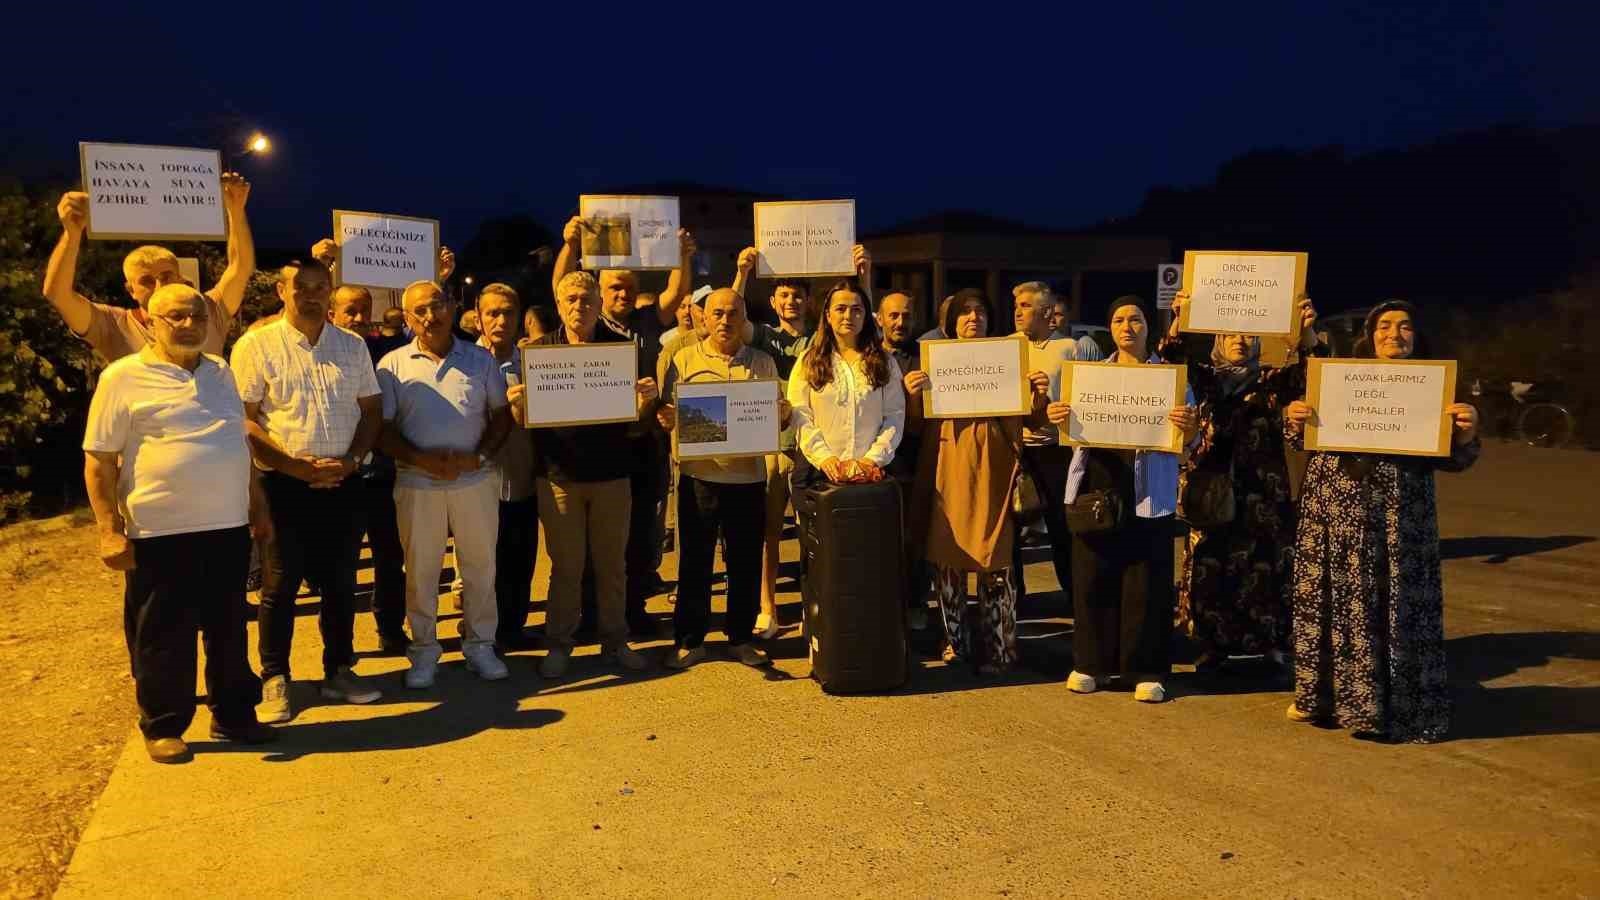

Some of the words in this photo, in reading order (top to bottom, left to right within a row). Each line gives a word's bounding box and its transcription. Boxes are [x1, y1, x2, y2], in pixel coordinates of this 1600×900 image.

[95, 159, 145, 172] İNSANA
[161, 162, 214, 175] TOPRAĞA
[92, 177, 150, 189] HAVAYA
[171, 178, 205, 189] SUYA
[96, 193, 149, 205] ZEHİRE
[163, 194, 204, 205] HAYIR
[344, 227, 425, 242] GELECEĞİMİZE
[367, 242, 407, 255] SAĞLIK
[354, 255, 416, 270] BIRAKALIM
[1222, 263, 1257, 273] DRONE
[1200, 277, 1279, 289] İLAÇLAMASINDA
[1214, 291, 1257, 302] DENETİM
[1217, 305, 1268, 317] İSTİYORUZ
[583, 360, 611, 368] ZARAR
[540, 373, 576, 381] VERMEK
[936, 365, 1005, 377] EKMEĞİMİZLE
[1344, 373, 1427, 384] KAVAKLARIMIZ
[537, 383, 576, 392] BİRLİKTE
[939, 382, 998, 393] OYNAMAYIN
[1354, 387, 1389, 399] DEĞİL
[1080, 392, 1167, 407] ZEHİRLENMEK
[1082, 408, 1165, 425] İSTEMİYORUZ
[1348, 404, 1405, 417] İHMALLER
[1345, 422, 1401, 432] KURUSUN
